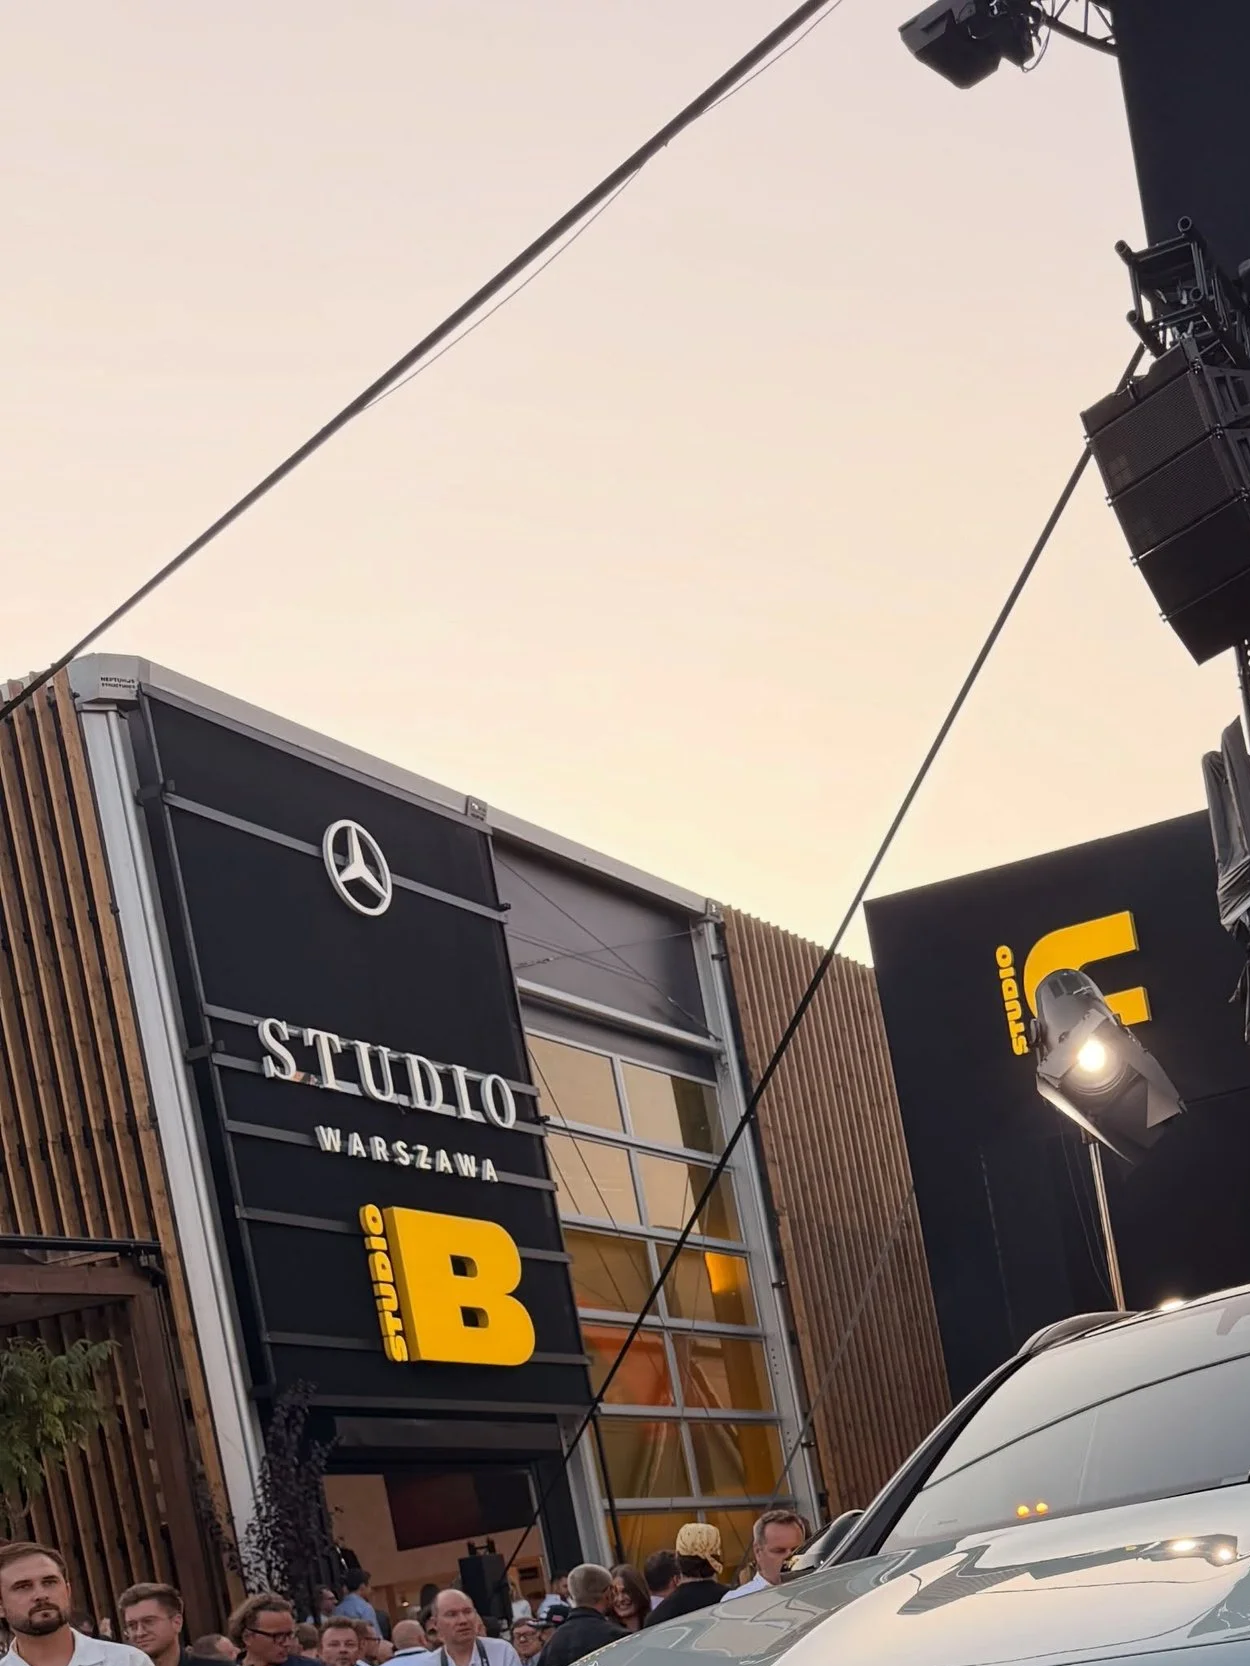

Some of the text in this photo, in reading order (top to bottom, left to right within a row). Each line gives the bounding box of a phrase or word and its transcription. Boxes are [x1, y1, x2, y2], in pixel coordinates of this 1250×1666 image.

[996, 945, 1029, 1056] STUDIO
[257, 1018, 516, 1129] STUDIO
[314, 1125, 498, 1182] WARSZAWA
[359, 1204, 408, 1362] STUDIO
[382, 1206, 535, 1366] B
